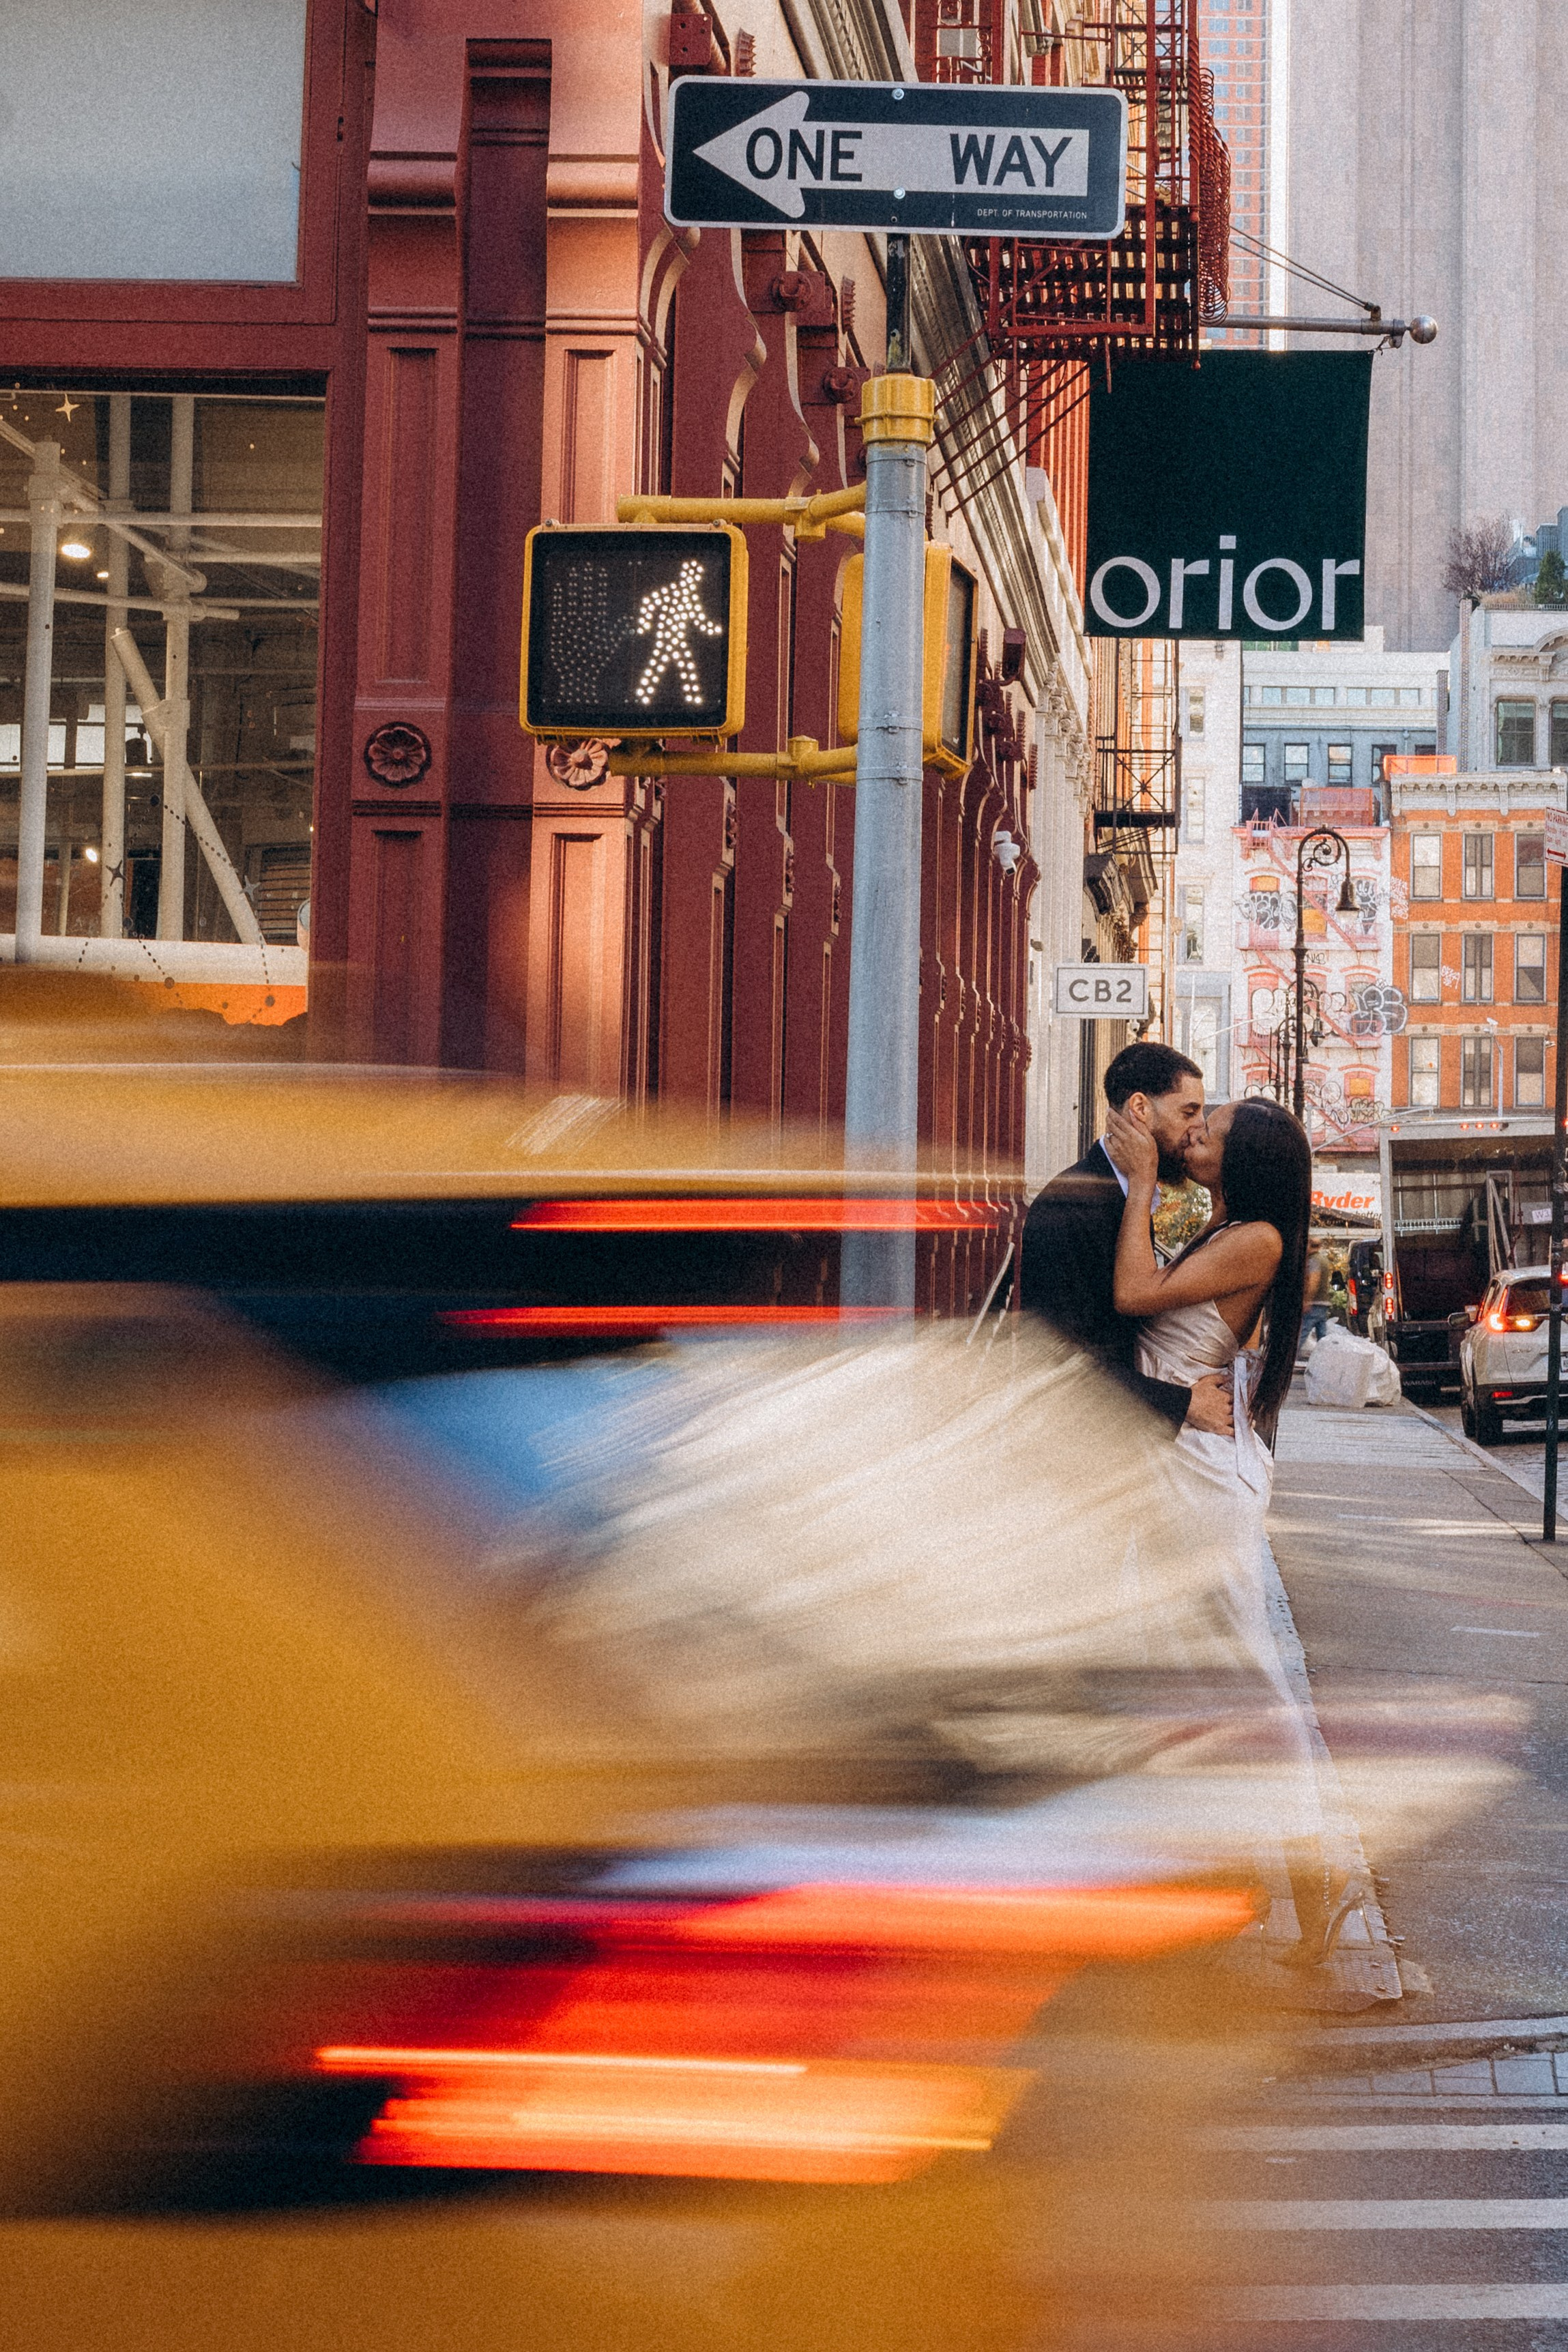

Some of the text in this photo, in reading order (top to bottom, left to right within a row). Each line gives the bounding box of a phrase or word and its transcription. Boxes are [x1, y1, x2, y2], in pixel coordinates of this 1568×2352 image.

[745, 127, 1073, 188] ONE WAY
[977, 208, 1088, 219] DEPT. OF TRANSPORTATION
[1090, 535, 1361, 630] orior
[1069, 978, 1132, 1003] CB2
[1311, 1191, 1375, 1208] Ryder
